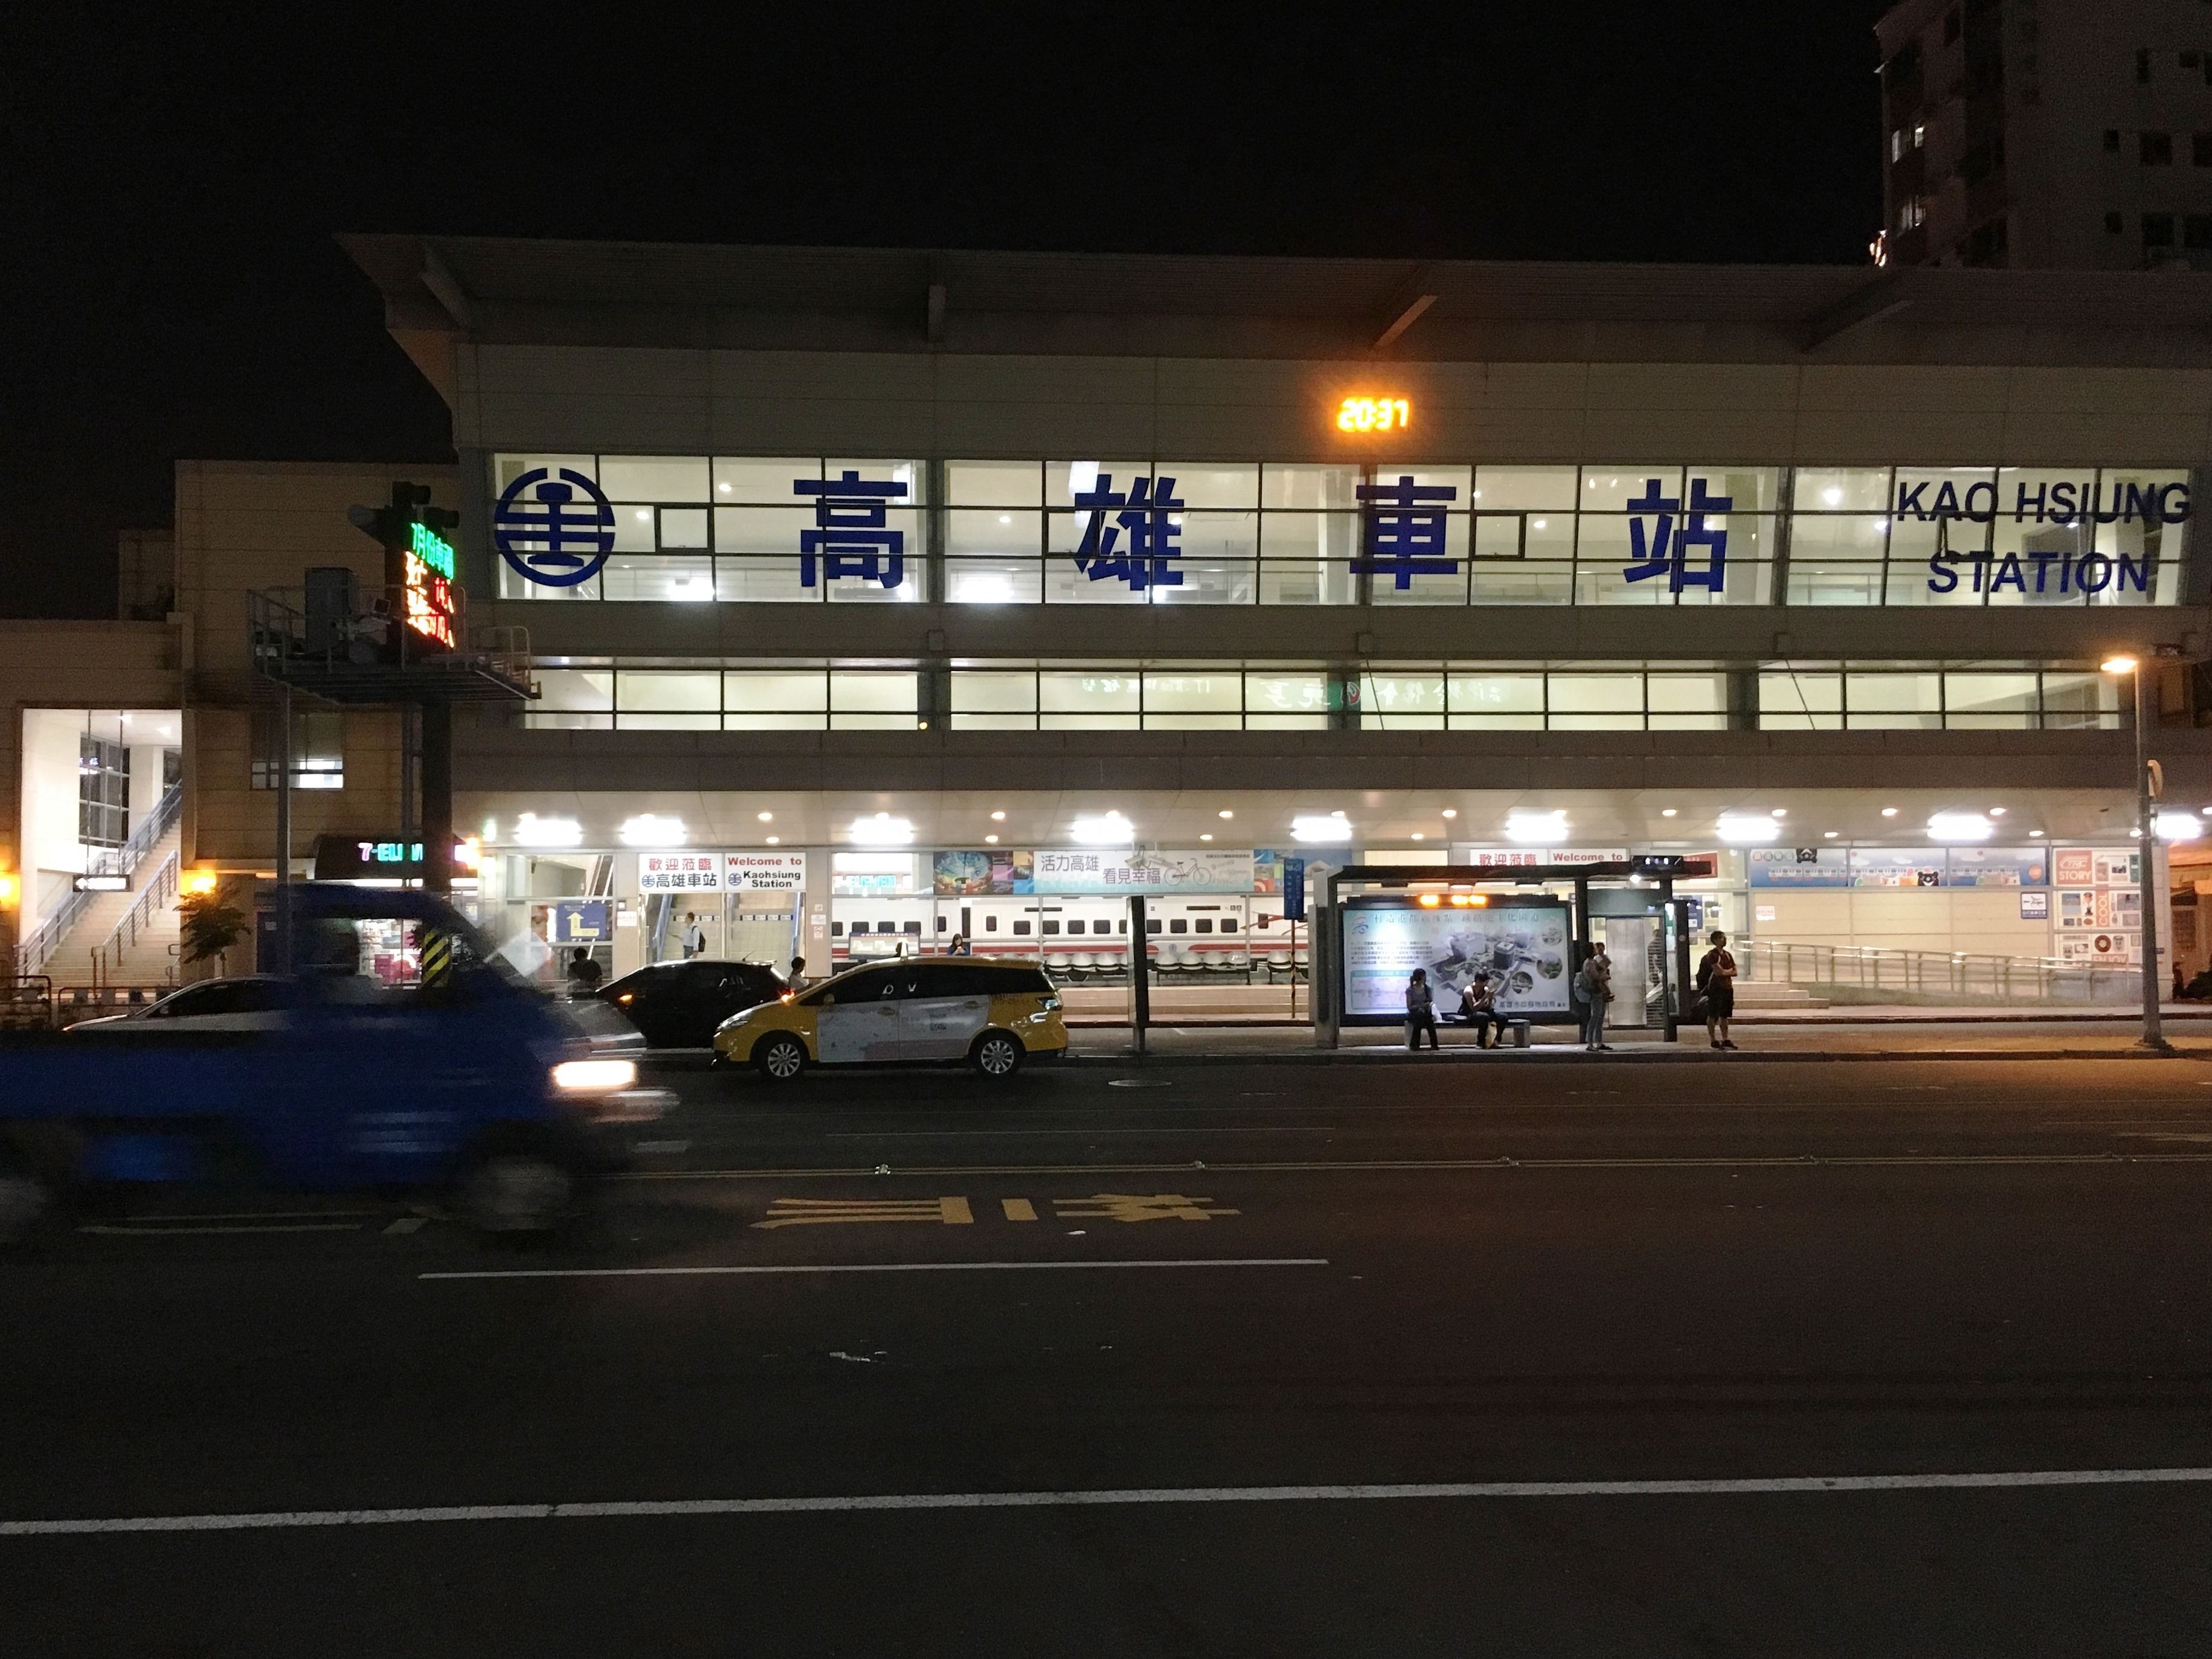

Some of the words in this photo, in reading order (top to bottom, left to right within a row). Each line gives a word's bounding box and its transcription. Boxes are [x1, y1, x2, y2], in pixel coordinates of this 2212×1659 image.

[1337, 397, 1409, 432] 20:37
[1897, 481, 1998, 524] KAO
[2013, 481, 2191, 525] HSIUNG
[793, 469, 1733, 594] 高雄車站
[1926, 550, 2152, 594] STATION
[649, 858, 712, 871] 歡迎蒞臨
[728, 857, 782, 865] Welcome
[790, 857, 802, 865] to
[1041, 855, 1099, 872] 活力高雄
[1479, 853, 1537, 866] 歡迎蒞臨
[1553, 853, 1605, 861] Welcome
[1612, 853, 1623, 861] to
[656, 872, 717, 888] 高雄車站
[744, 870, 801, 881] Kaohsiung
[751, 879, 793, 888] Station
[1102, 867, 1161, 885] 看見幸福
[2059, 870, 2092, 881] STORY
[2098, 893, 2108, 926] COOL
